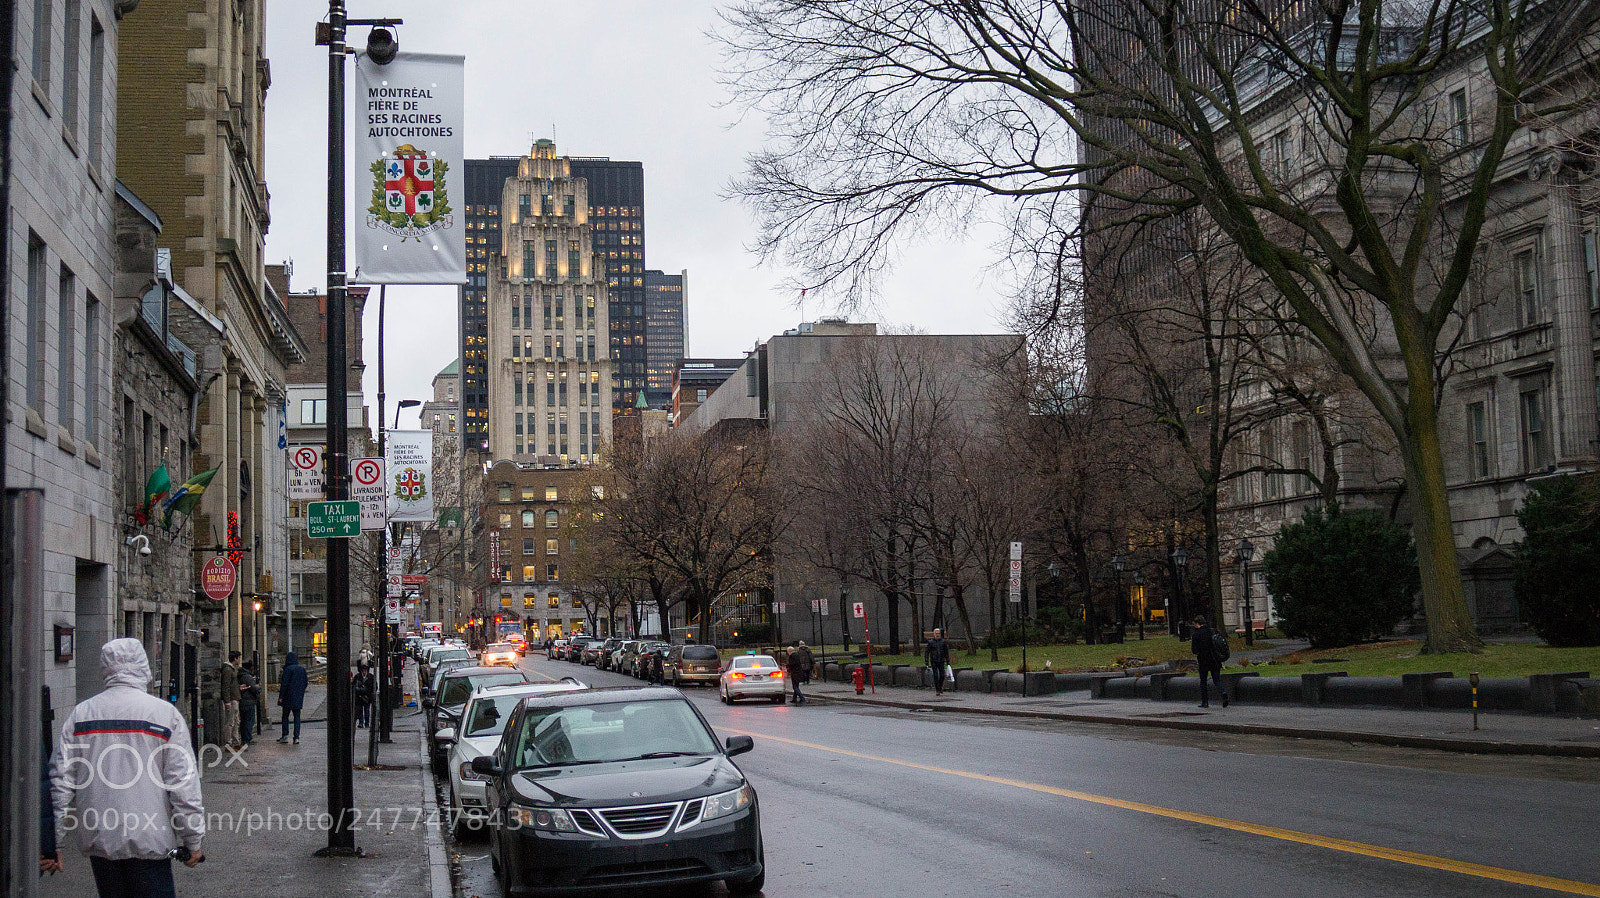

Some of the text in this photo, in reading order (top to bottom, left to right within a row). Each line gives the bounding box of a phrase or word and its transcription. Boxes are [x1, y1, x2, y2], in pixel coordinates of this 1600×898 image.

[368, 87, 433, 98] MONTRÉAL
[368, 99, 418, 111] FIÈRE DE
[368, 114, 442, 124] SES RACINES
[368, 127, 453, 138] AUTOCHTONES
[353, 487, 383, 495] LIVRAISON
[323, 504, 345, 515] TAXI
[327, 515, 360, 523] ST-LAURENT
[372, 511, 384, 519] VEN
[311, 525, 326, 534] 250
[206, 567, 231, 575] RODIZIO
[206, 574, 231, 583] BRASIL
